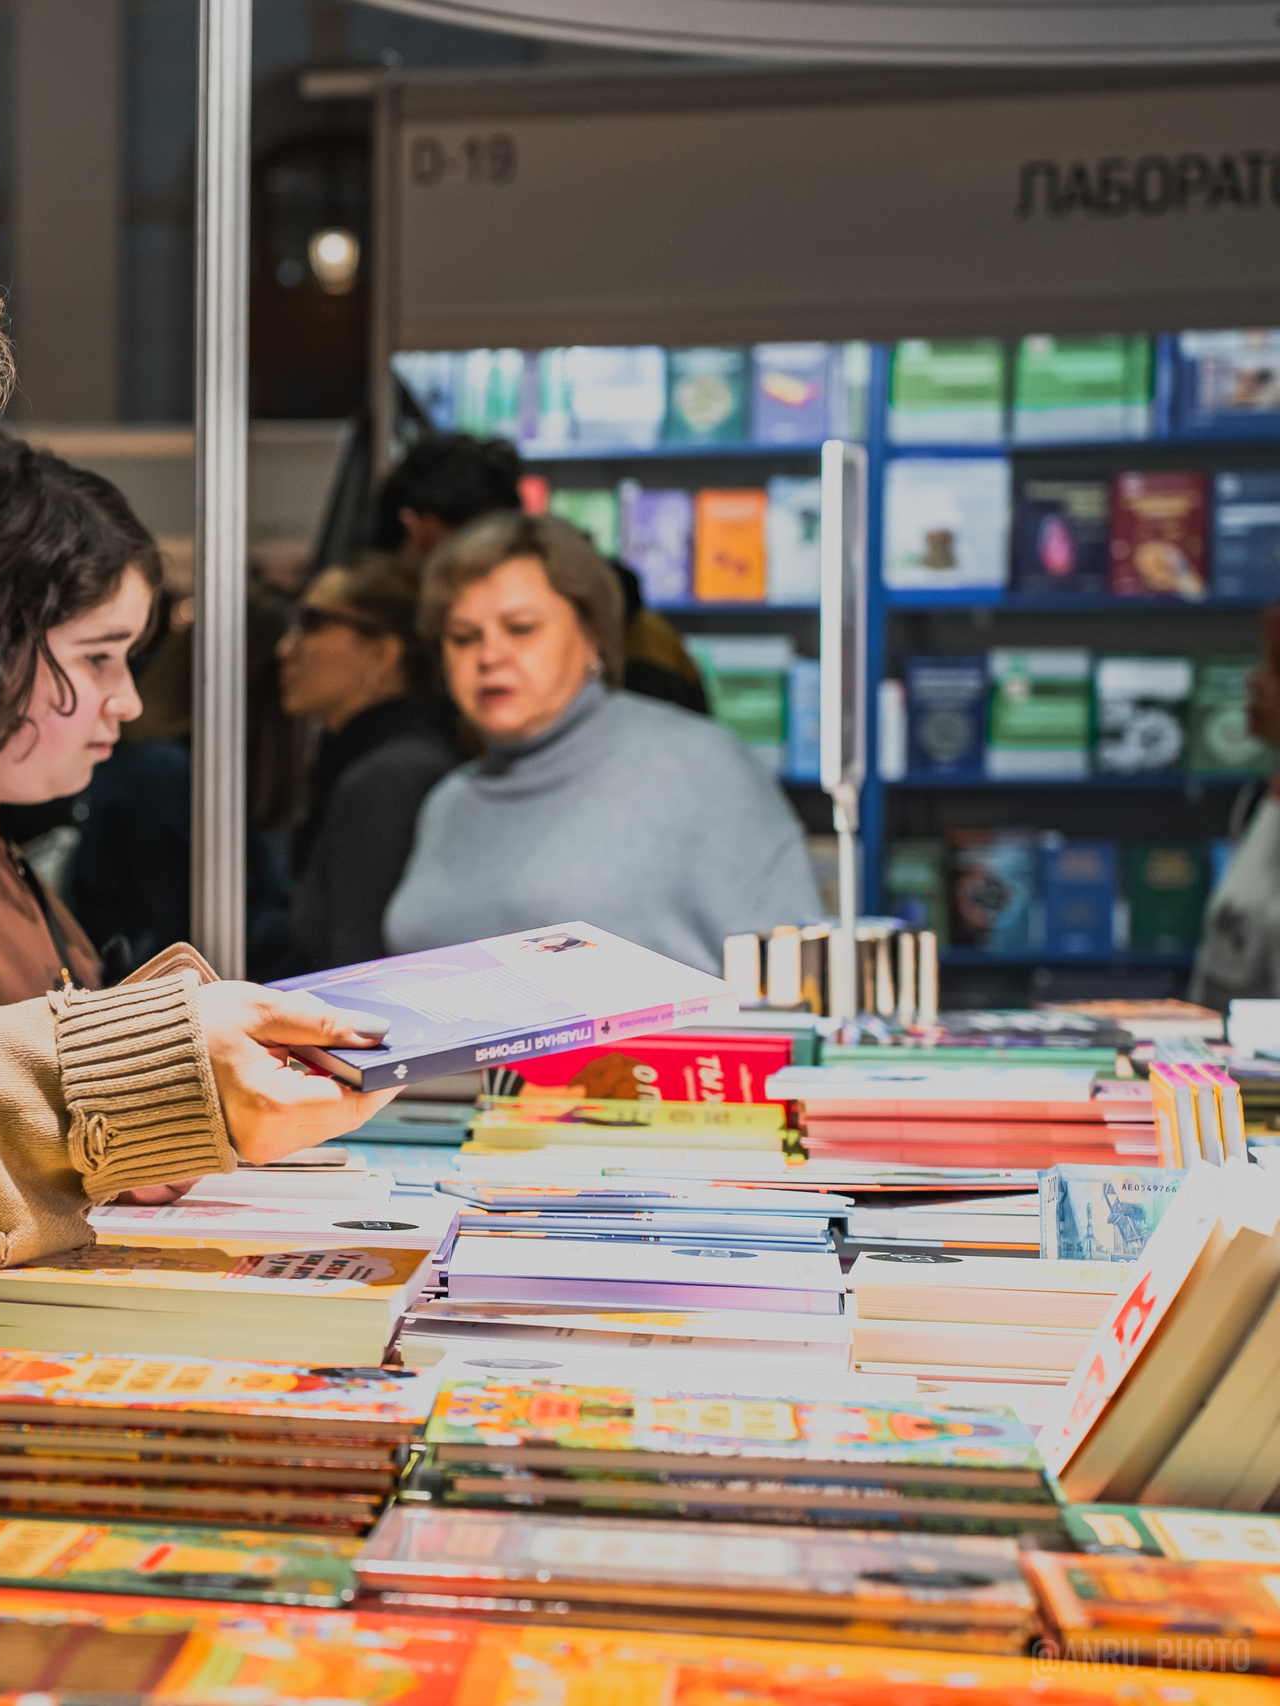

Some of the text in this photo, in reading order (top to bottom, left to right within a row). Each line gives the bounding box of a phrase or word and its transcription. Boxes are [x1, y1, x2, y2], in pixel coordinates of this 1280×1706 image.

[1015, 151, 1280, 220] ЛАБОРАТ
[475, 1026, 592, 1062] ГЛАВНАЯ ГЕРОИНЯ
[1121, 1183, 1180, 1193] AE0549766
